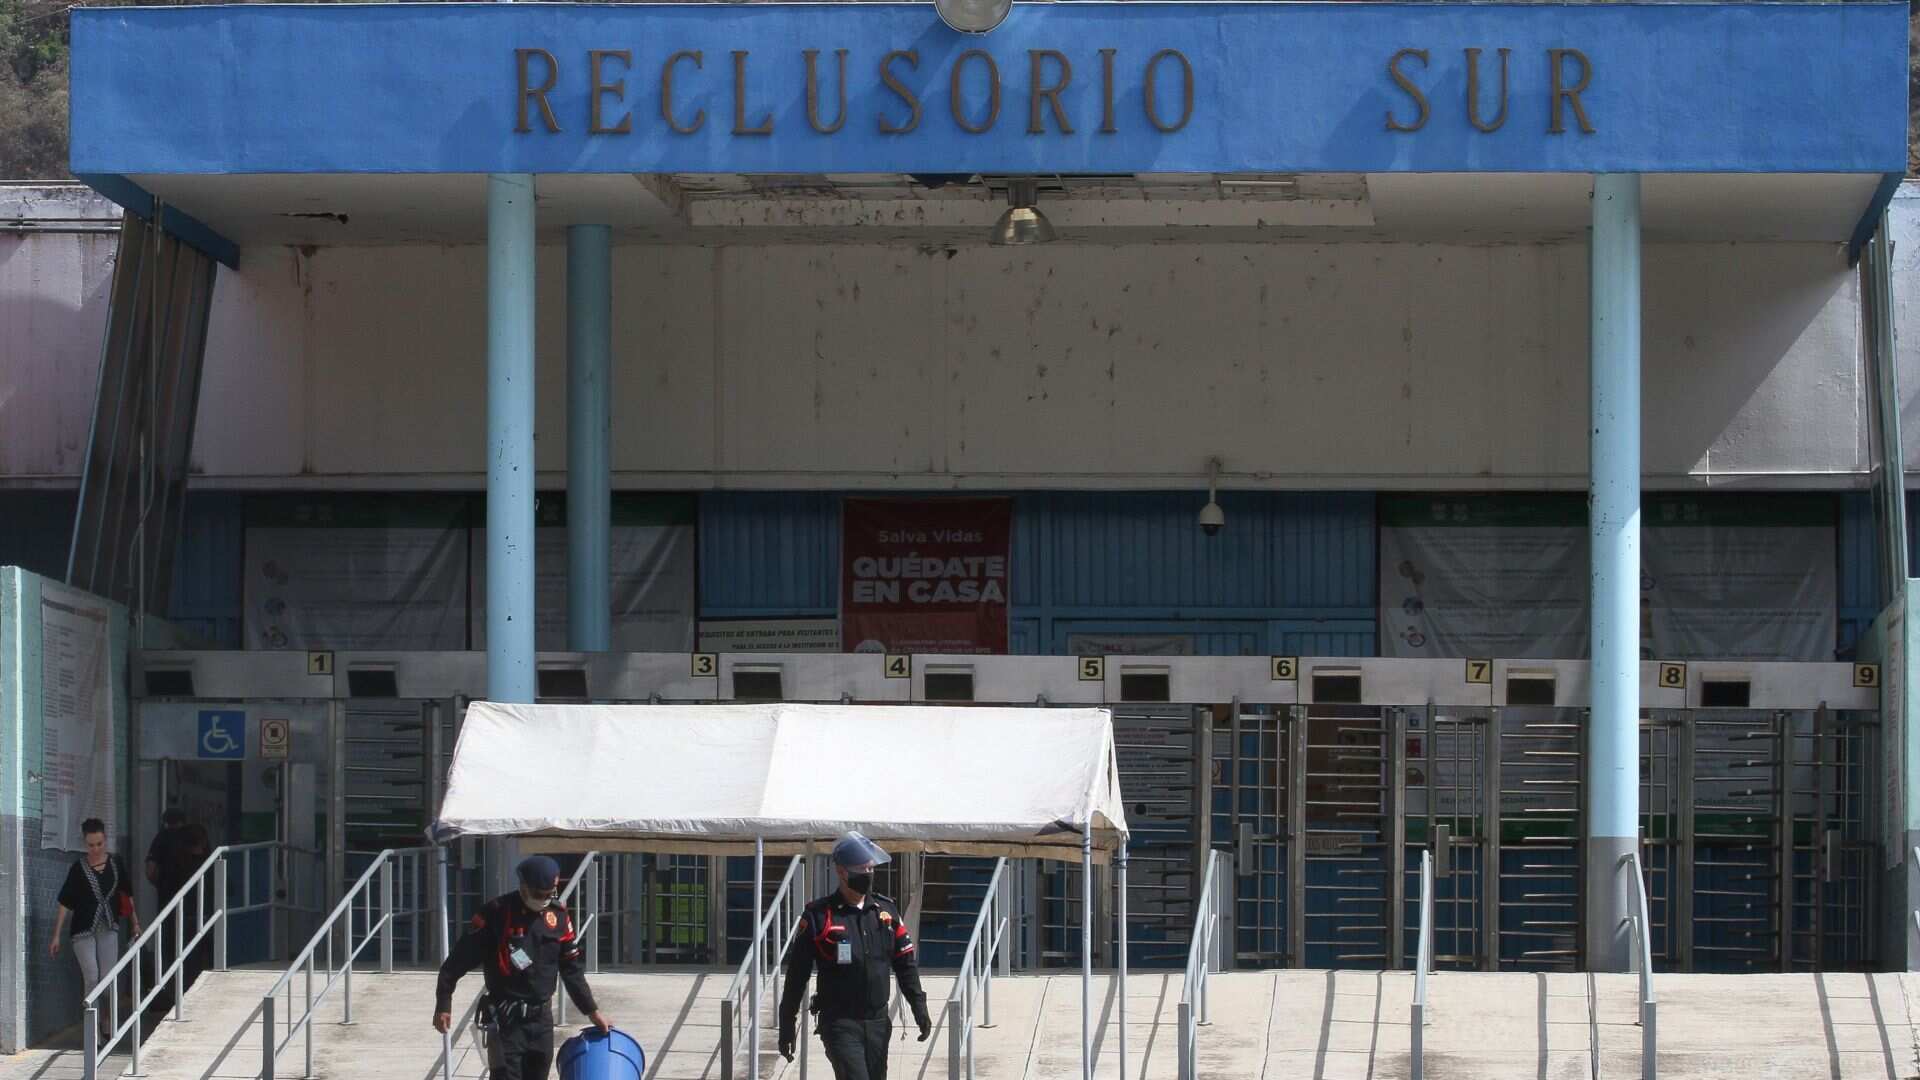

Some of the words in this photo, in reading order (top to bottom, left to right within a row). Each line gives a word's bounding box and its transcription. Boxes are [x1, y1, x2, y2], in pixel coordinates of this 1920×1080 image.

[513, 47, 1195, 135] RECLUSORIO
[1384, 47, 1597, 135] SUR
[878, 529, 927, 543] Salva
[932, 529, 984, 543] Vidas
[853, 552, 1005, 578] QUÉDATE
[853, 580, 900, 603] EN
[907, 579, 1006, 603] CASA
[314, 654, 325, 672] 1
[697, 656, 713, 674] 3
[890, 656, 906, 675] 4
[1084, 659, 1099, 677] 5
[1276, 659, 1291, 677] 6
[1471, 662, 1488, 680] 7
[1665, 666, 1681, 685] 8
[1859, 666, 1875, 684] 9
